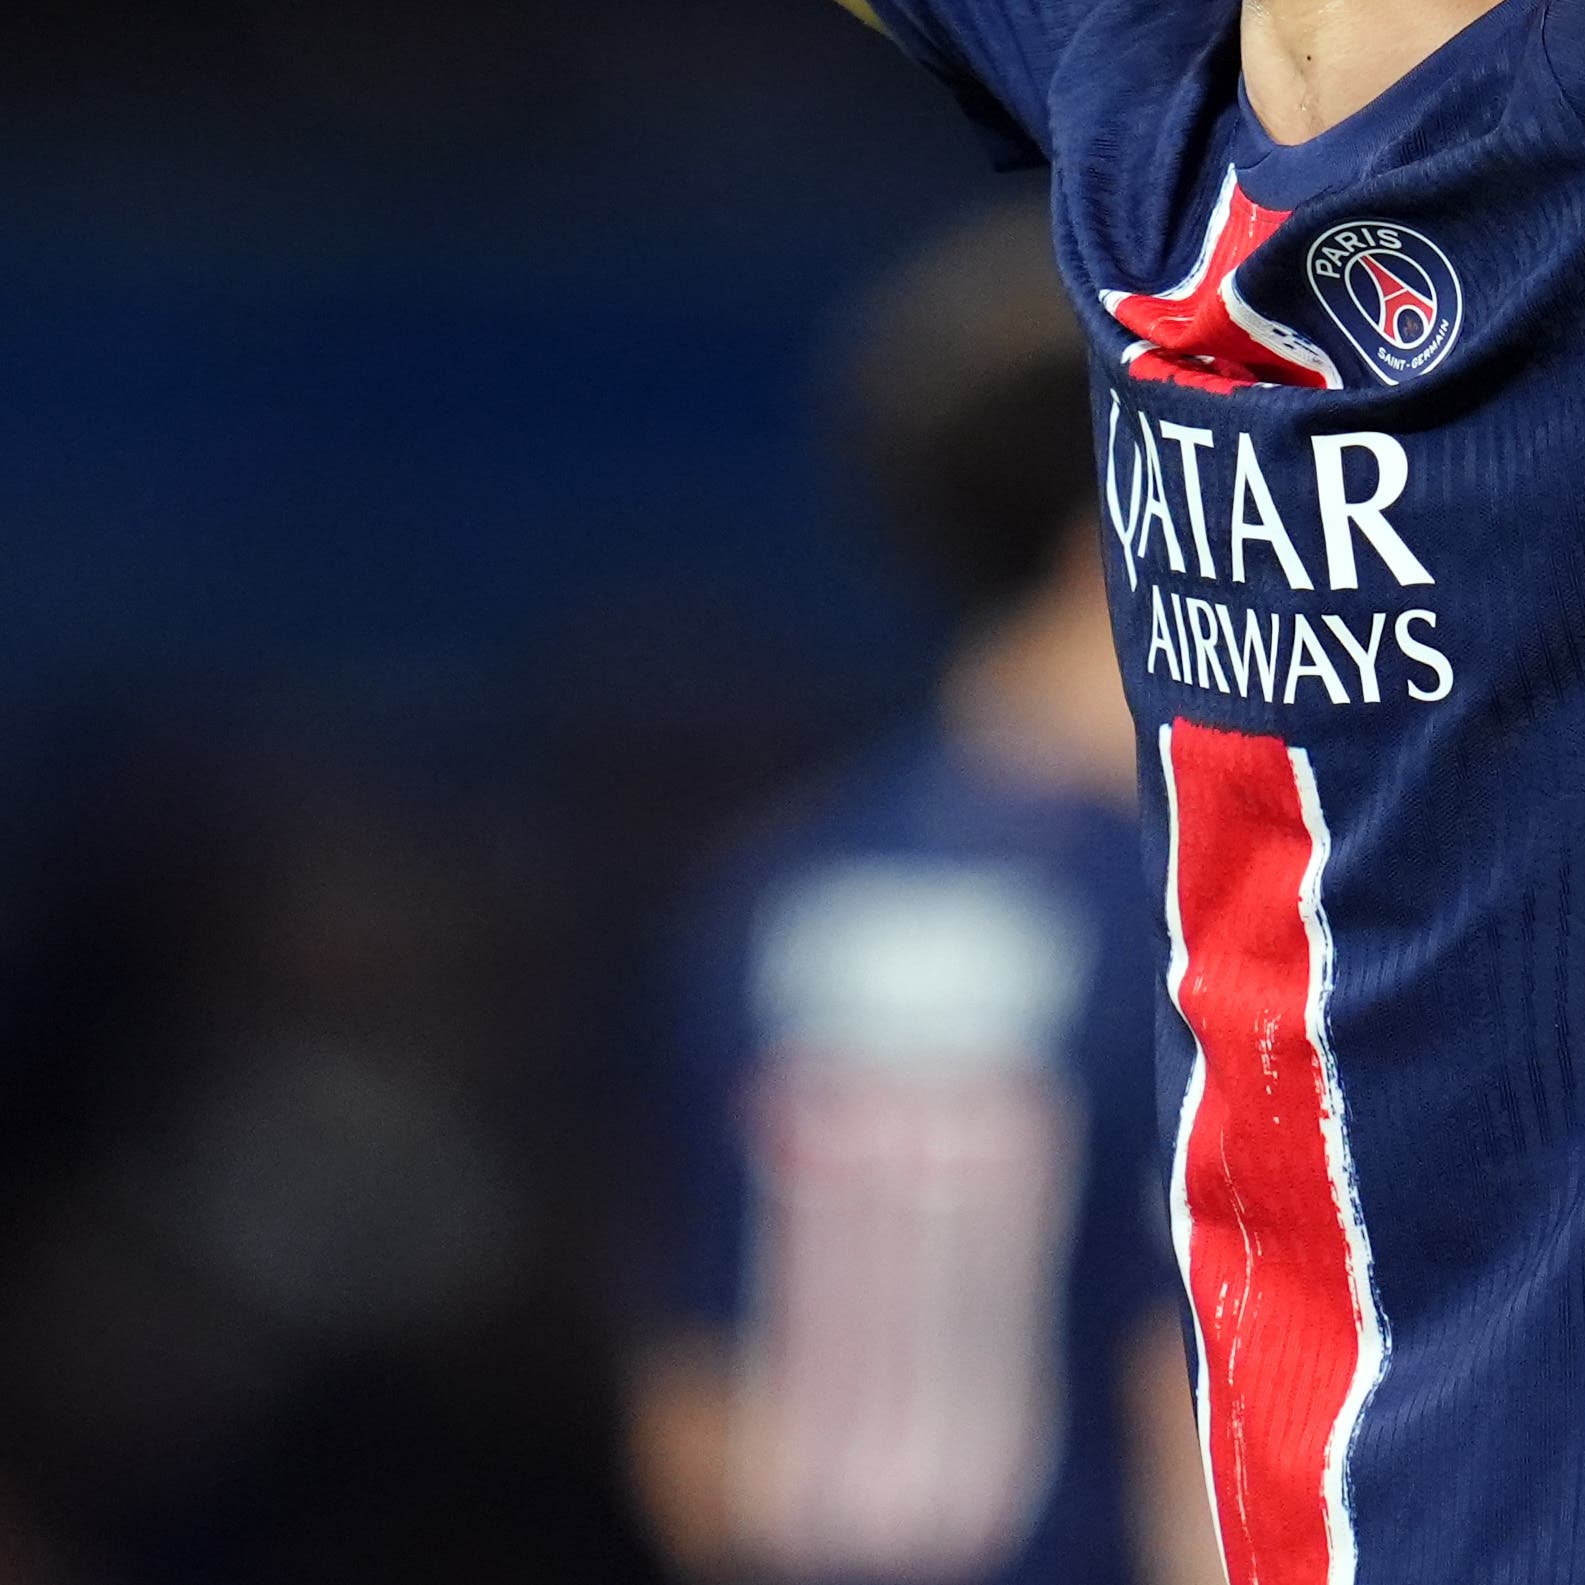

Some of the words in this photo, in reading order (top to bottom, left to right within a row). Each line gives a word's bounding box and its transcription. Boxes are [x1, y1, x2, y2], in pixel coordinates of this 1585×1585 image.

[1316, 228, 1402, 278] PARIS
[1377, 319, 1450, 371] SAINT-GERMAIN
[1147, 585, 1455, 704] AIRWAYS
